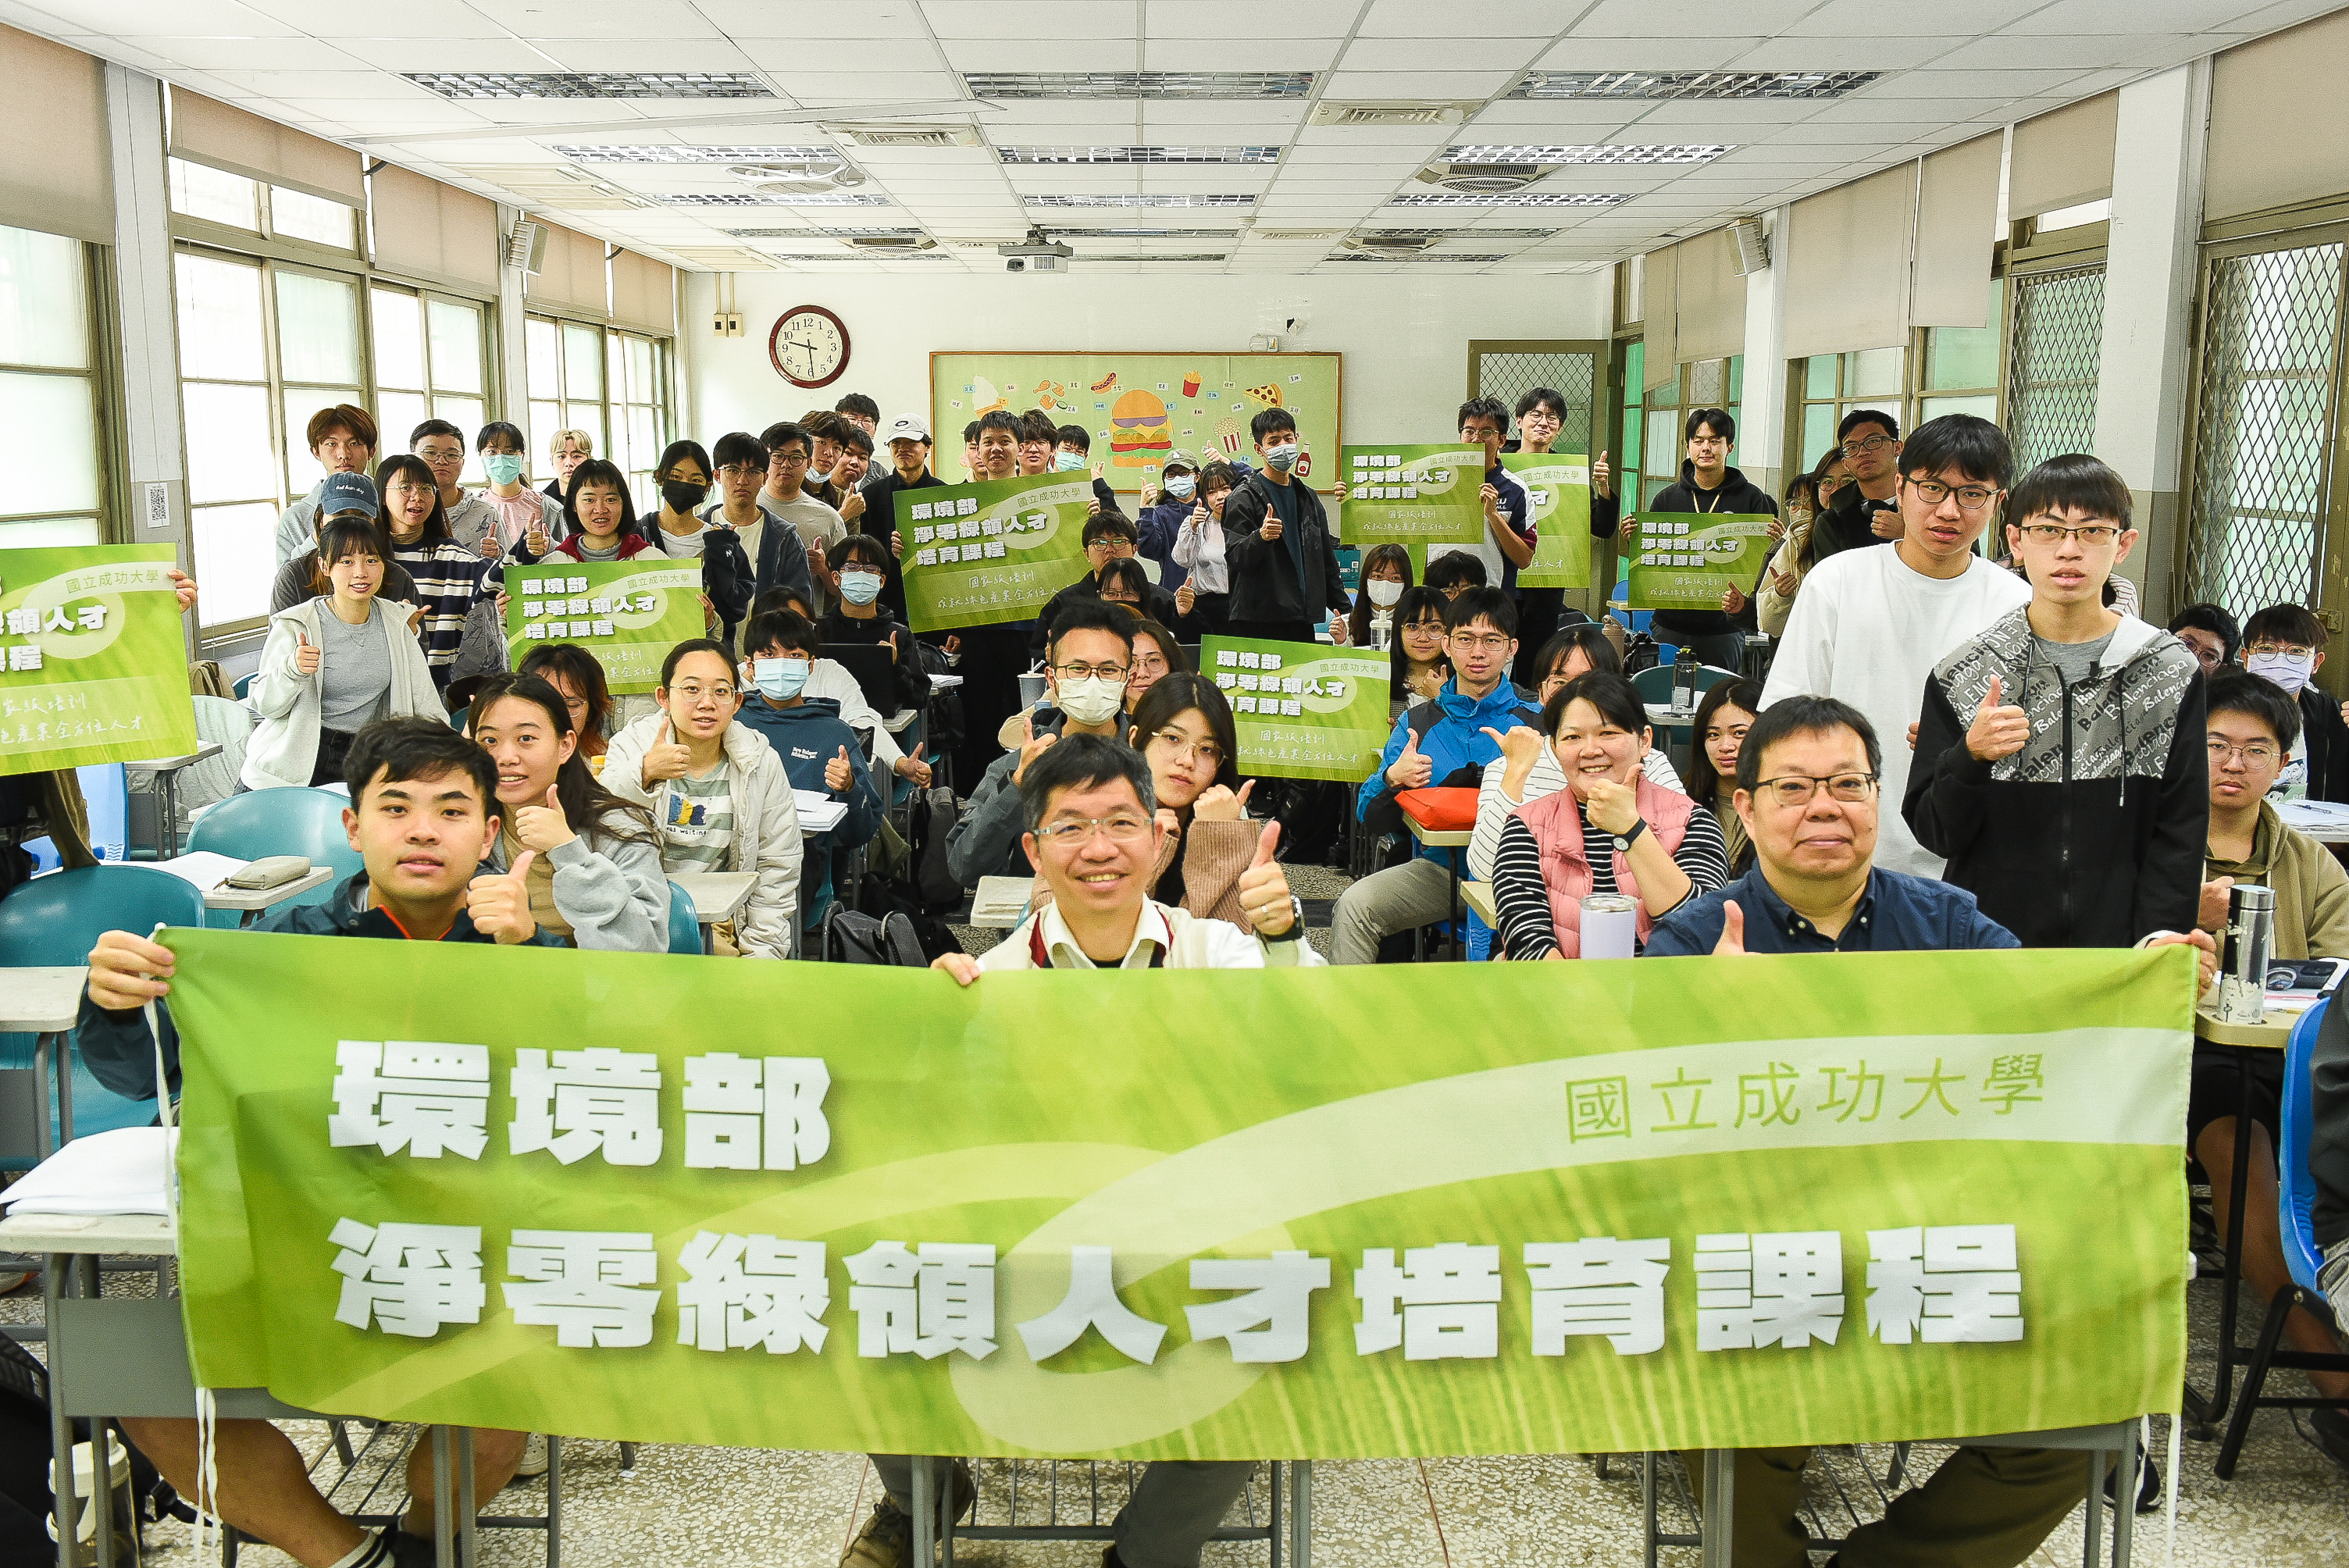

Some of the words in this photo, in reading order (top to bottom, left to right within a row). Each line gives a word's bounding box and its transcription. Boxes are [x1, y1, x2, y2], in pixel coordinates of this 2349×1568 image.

[792, 321, 801, 330] 11
[803, 317, 813, 328] 12
[818, 321, 823, 330] 1
[783, 331, 793, 340] 10
[827, 330, 833, 339] 2
[782, 344, 788, 353] 9
[831, 342, 837, 351] 3
[786, 356, 793, 365] 8
[827, 355, 833, 363] 4
[795, 365, 801, 374] 7
[808, 367, 814, 377] 6
[820, 364, 826, 373] 5
[1353, 455, 1402, 467] 環境部
[1353, 470, 1450, 483] 淨零綠領人才
[1524, 470, 1579, 483] 國立成功大學
[1017, 487, 1081, 508] 國立成功大學
[1353, 487, 1417, 499] 培育課程
[911, 497, 978, 520] 環境部
[913, 513, 1048, 543] 淨零綠領人才
[1641, 522, 1690, 535] 環境部
[1641, 538, 1738, 551] 淨零綠領人才
[916, 540, 1006, 566] 培育課程
[1641, 554, 1705, 567] 培育課程
[66, 570, 159, 593] 國立成功大學
[521, 577, 588, 595] 環境部
[627, 574, 690, 589] 國立成功大學
[522, 595, 656, 617] 淨零綠領人才
[0, 604, 108, 636] 領人才
[525, 619, 614, 639] 培育課程
[1216, 650, 1282, 670] 環境部
[1320, 663, 1380, 674] 國立成功大學
[1216, 672, 1345, 697] 淨零綠領人才
[2104, 660, 2188, 721] Balenciaga
[1565, 1052, 2045, 1144] 國立成功大學
[327, 1039, 832, 1171] 環境部
[327, 1217, 2026, 1365] 淨零綠領人才培育課程
